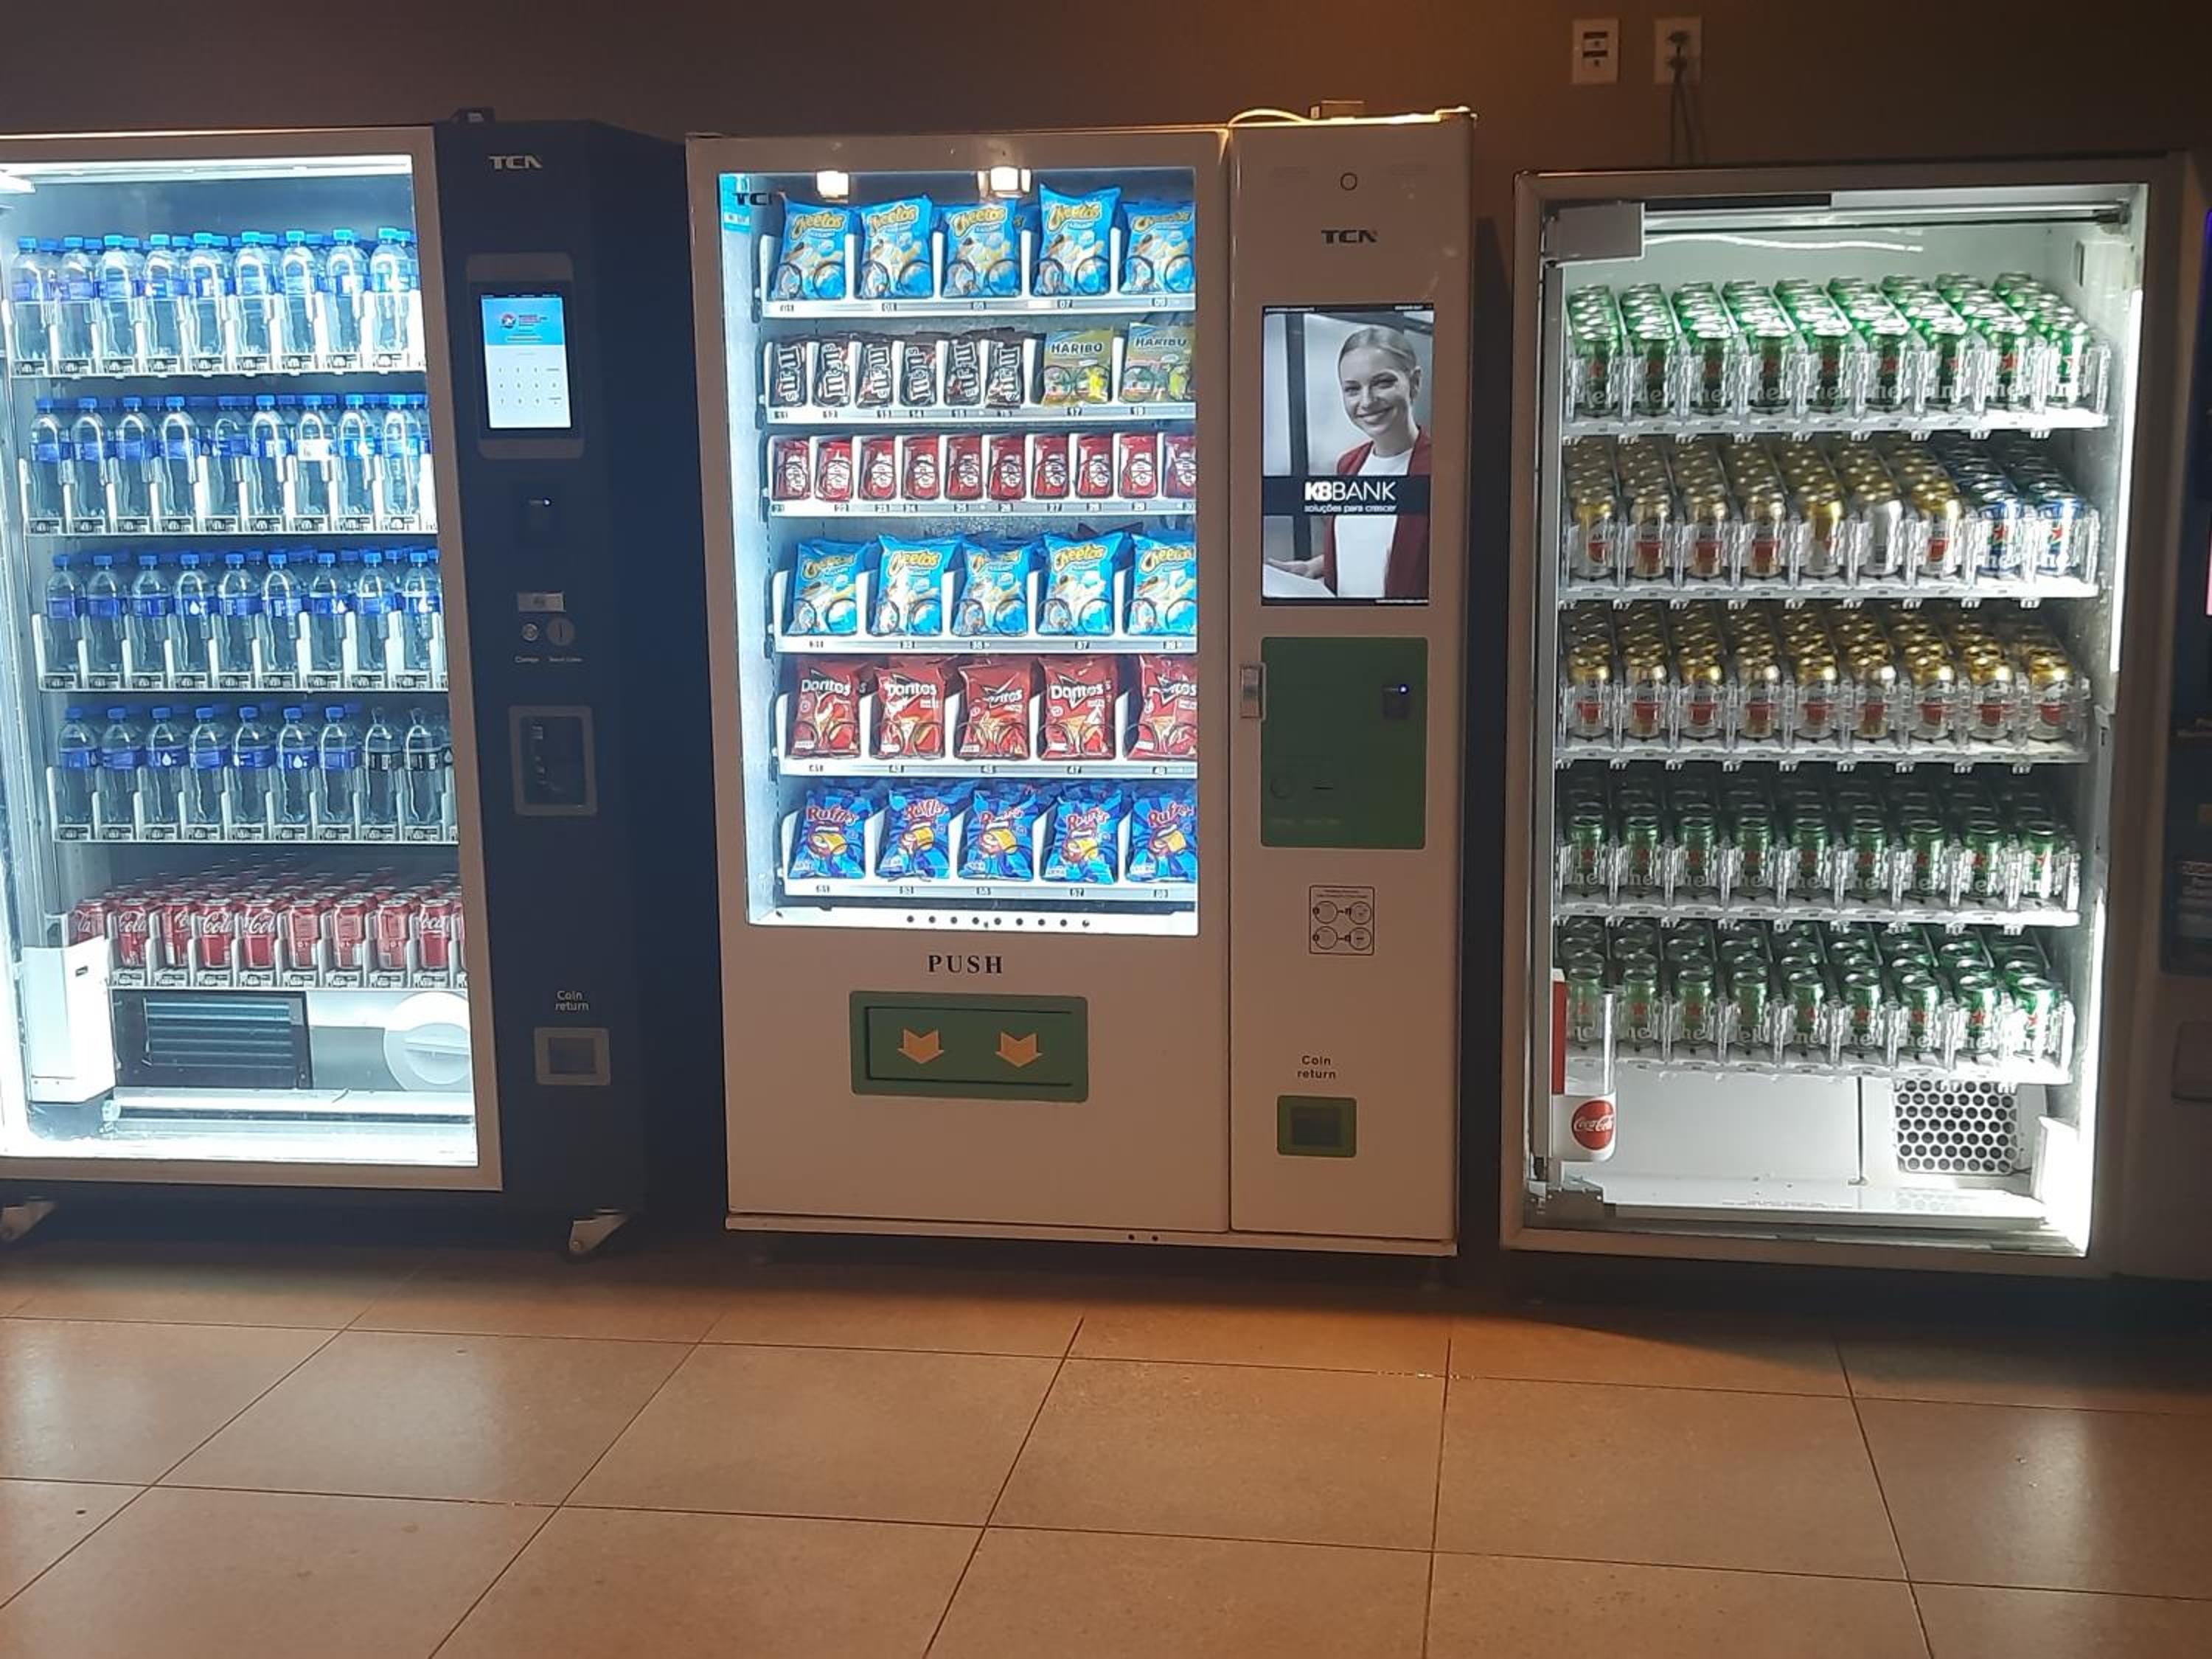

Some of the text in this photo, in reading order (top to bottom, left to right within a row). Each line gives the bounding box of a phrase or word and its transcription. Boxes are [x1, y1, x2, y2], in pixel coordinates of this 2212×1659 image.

[1051, 343, 1104, 354] HARIBO
[1343, 504, 1363, 513] para
[801, 679, 852, 695] Doritos
[887, 681, 936, 698] Doritos
[1051, 684, 1104, 699] Doritos
[928, 955, 1003, 974] PUSH
[557, 990, 583, 1001] Coin
[555, 1001, 590, 1012] return
[1301, 1054, 1332, 1066] Coin
[1297, 1068, 1336, 1080] return
